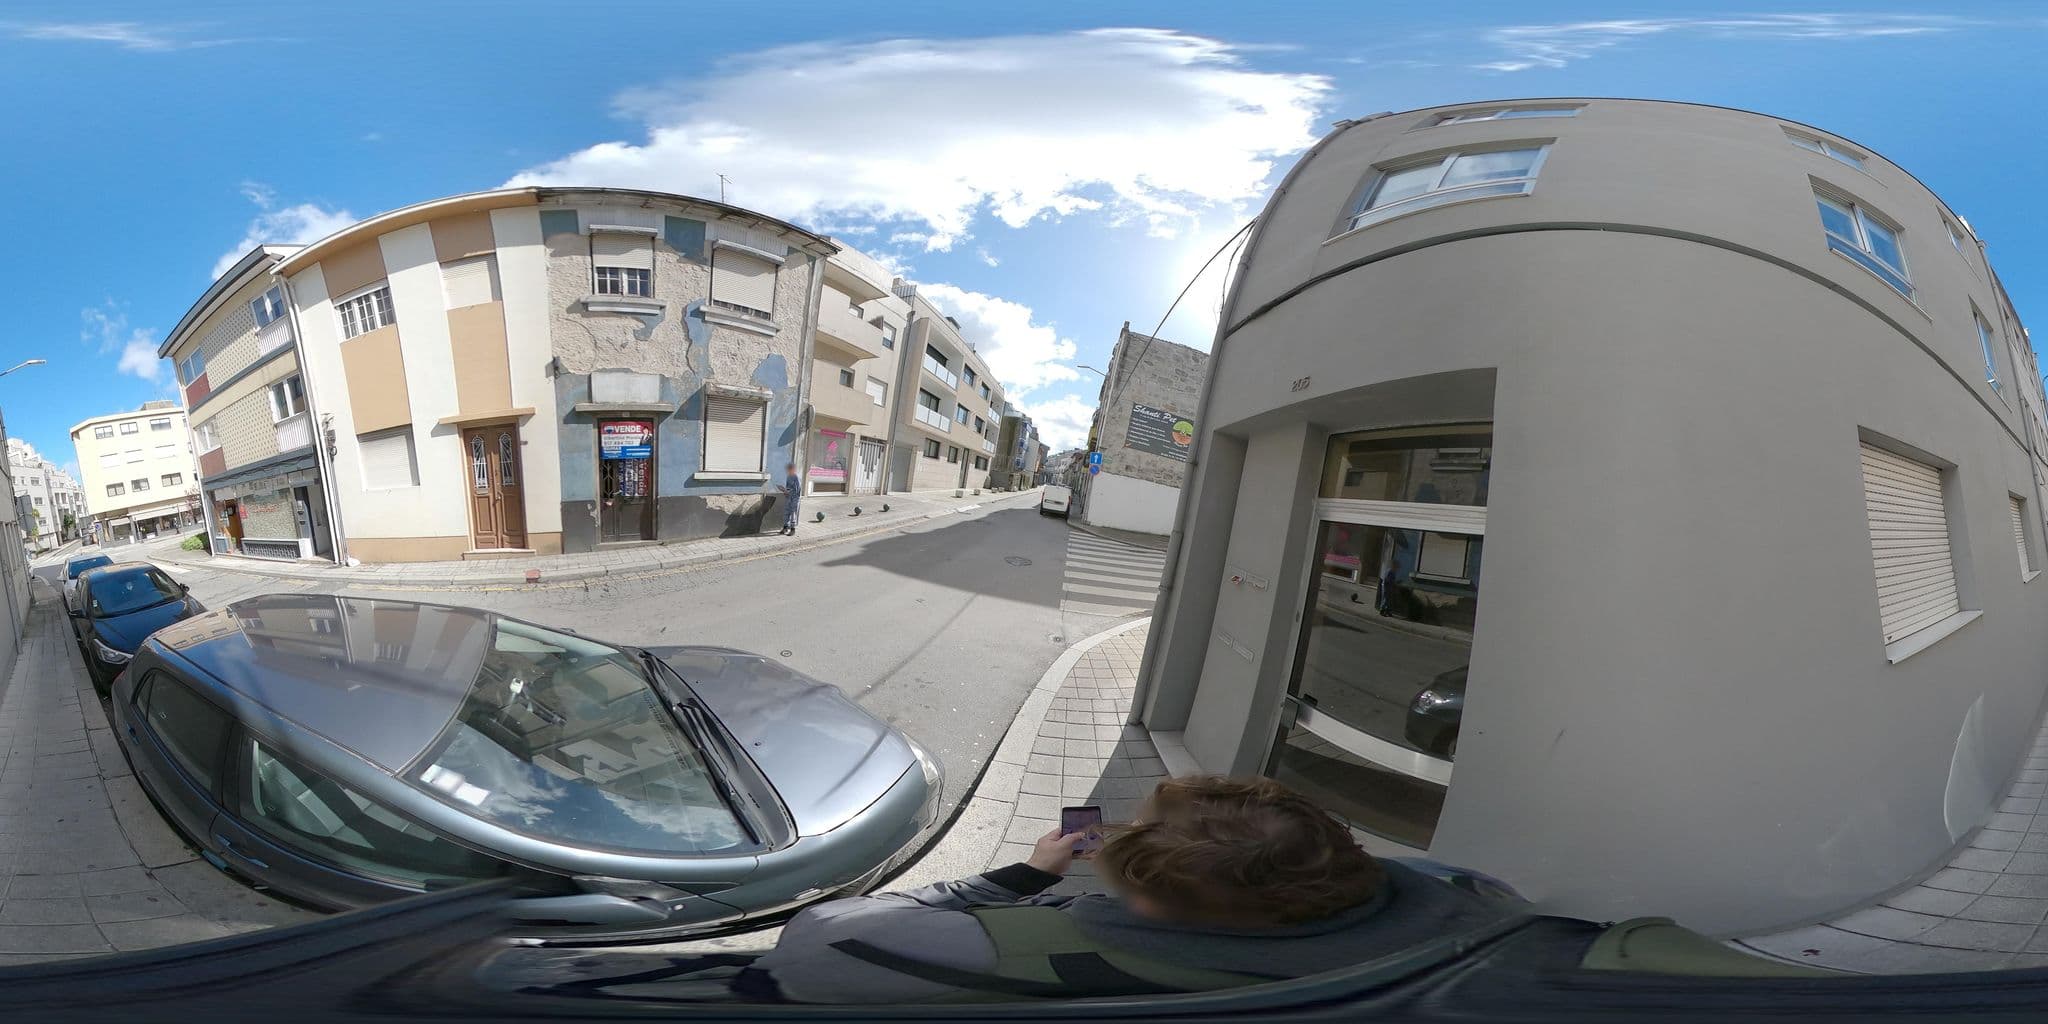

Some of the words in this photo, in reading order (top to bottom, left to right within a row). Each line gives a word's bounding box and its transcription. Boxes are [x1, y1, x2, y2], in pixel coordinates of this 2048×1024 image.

[1133, 405, 1161, 418] Shanti
[1162, 413, 1177, 423] Pet
[614, 425, 642, 433] VENDE
